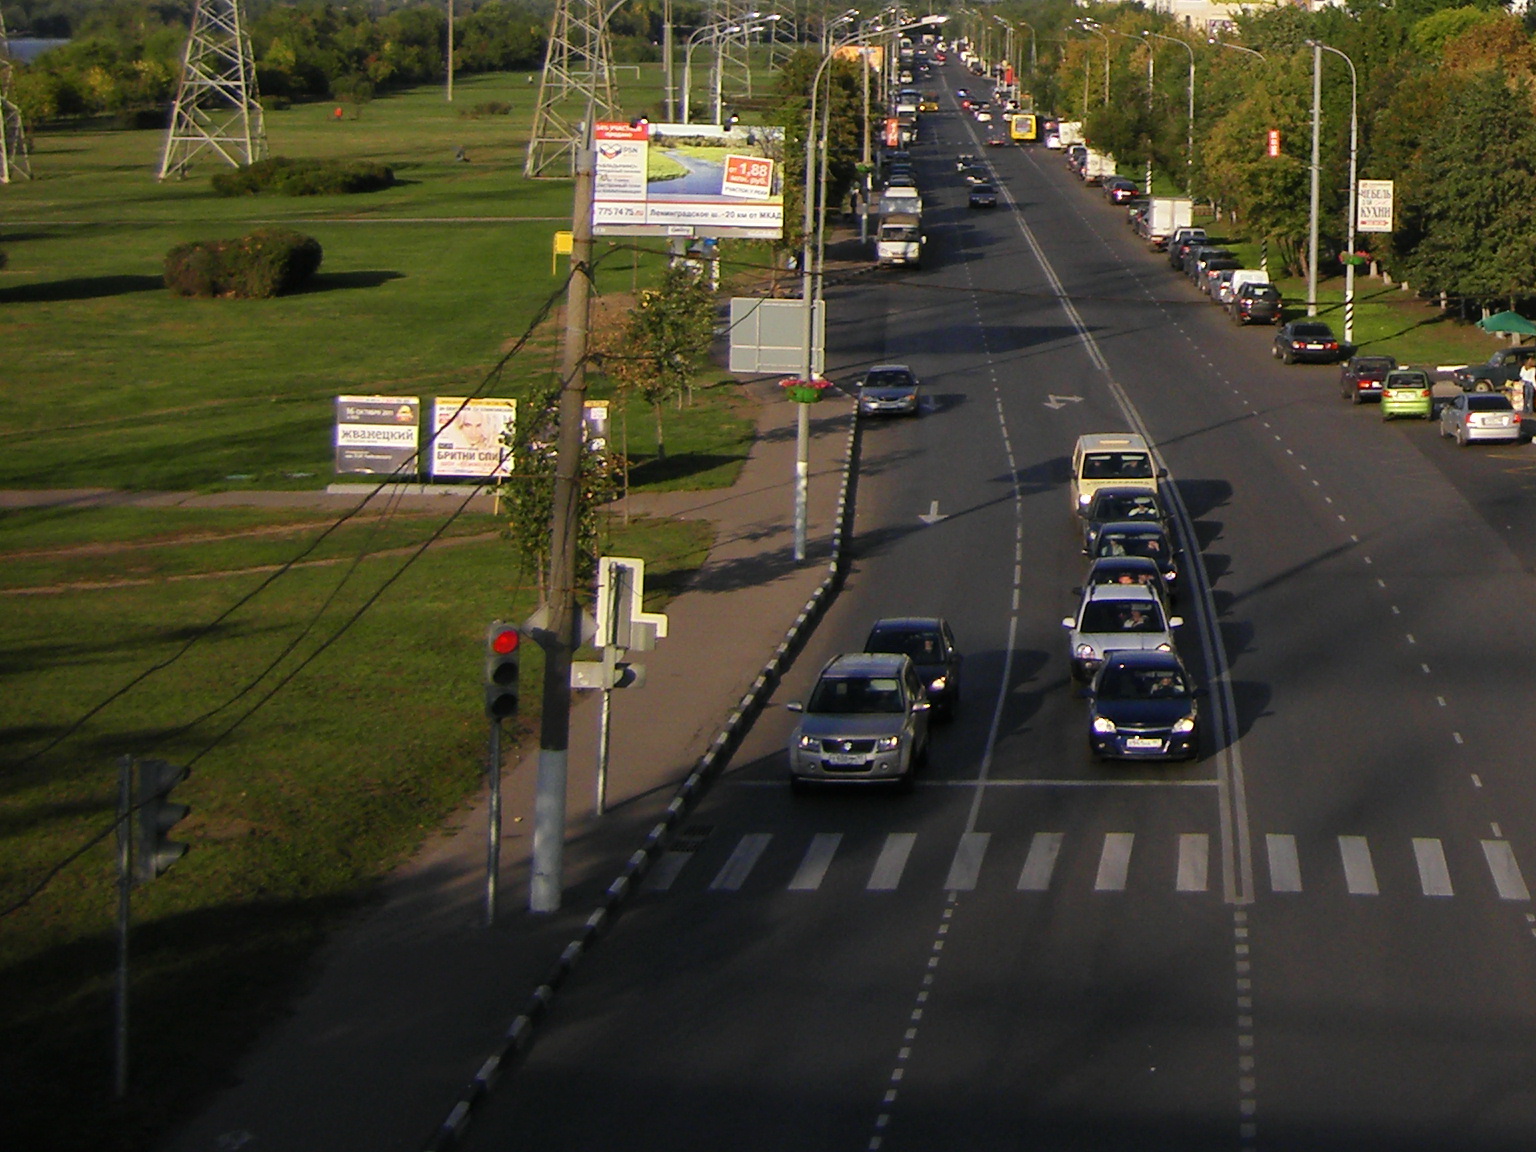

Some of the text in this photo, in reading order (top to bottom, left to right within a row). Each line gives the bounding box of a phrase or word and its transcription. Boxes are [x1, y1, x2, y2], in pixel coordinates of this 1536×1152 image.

[739, 162, 768, 177] 1,88
[760, 212, 783, 220] МКАД
[1361, 207, 1391, 218] КУХНИ
[341, 429, 414, 442] жванецкий
[437, 451, 476, 461] БРИТНИ
